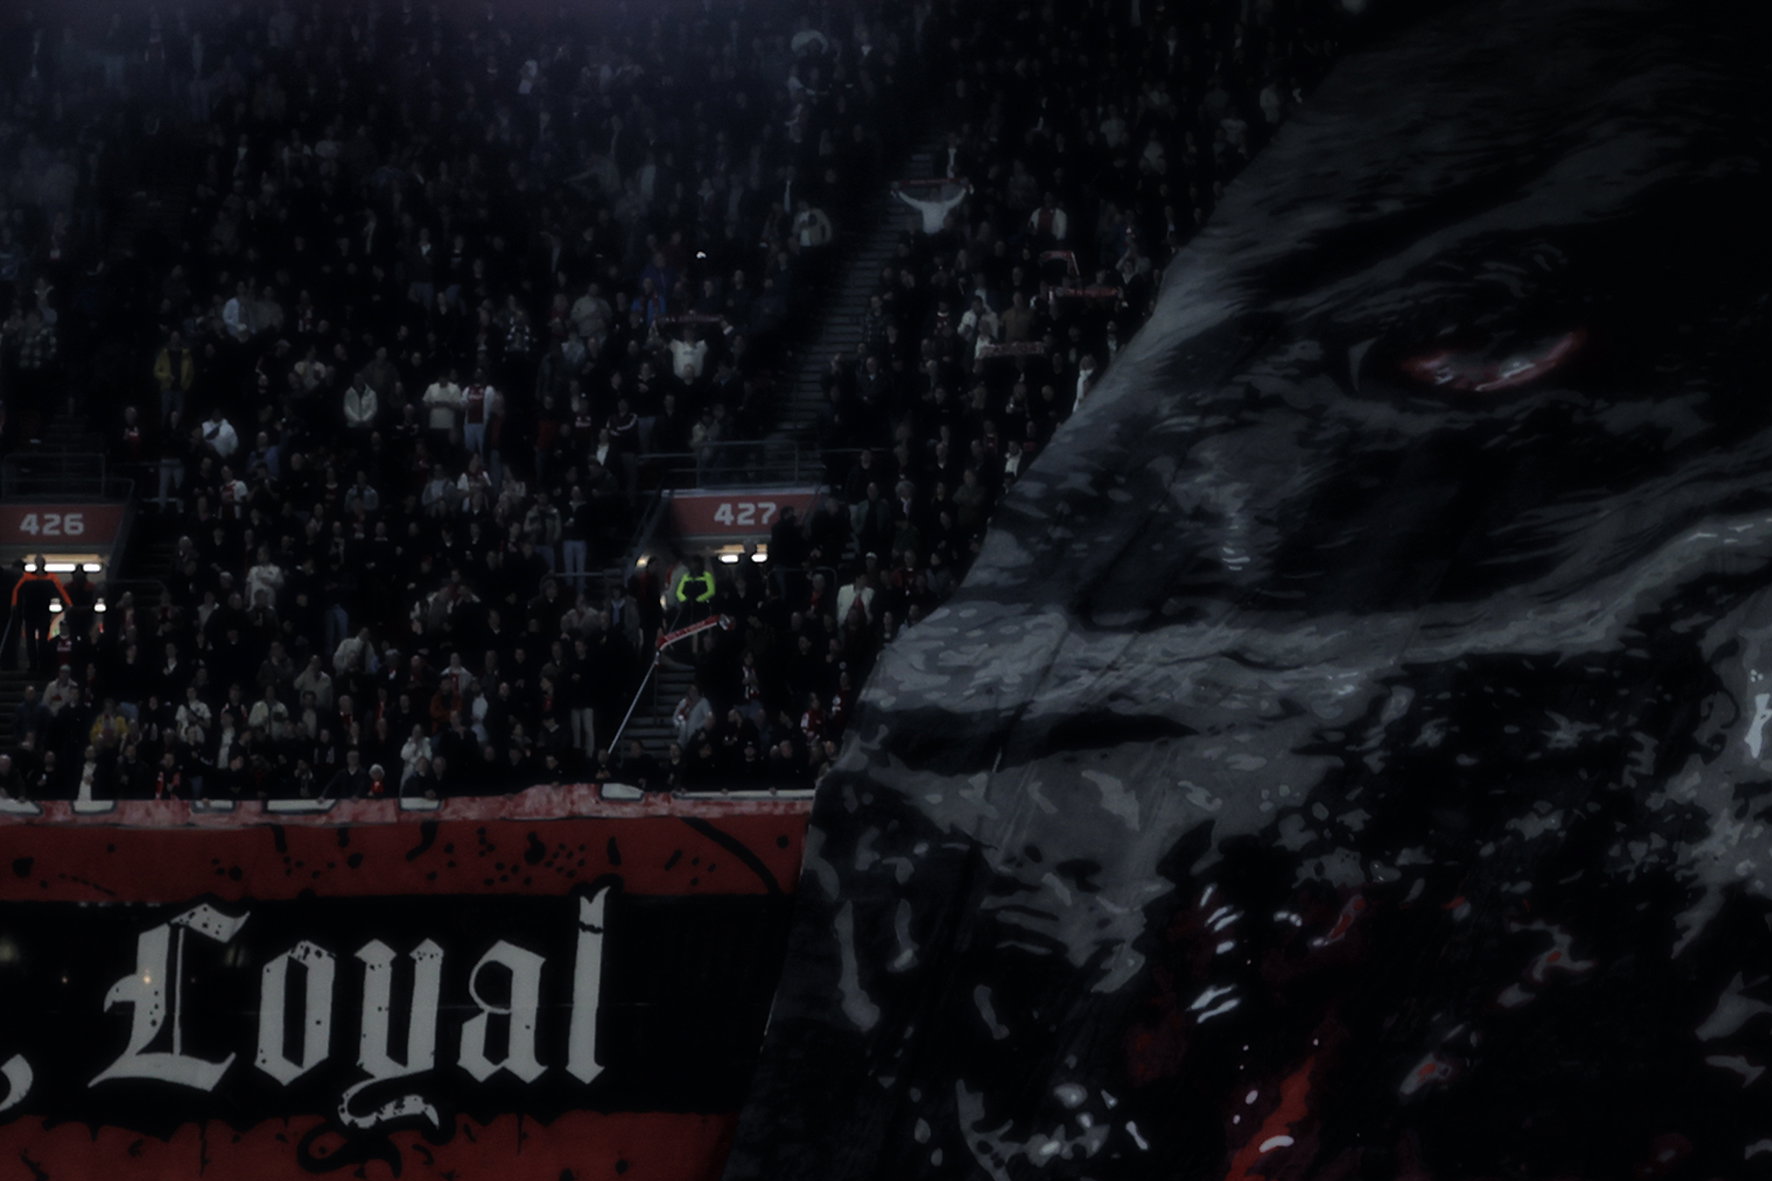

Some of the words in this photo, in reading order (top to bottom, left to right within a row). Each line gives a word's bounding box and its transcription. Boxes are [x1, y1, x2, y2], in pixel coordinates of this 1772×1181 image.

[19, 512, 85, 536] 426
[713, 502, 777, 526] 427
[87, 885, 611, 1129] Loyal
